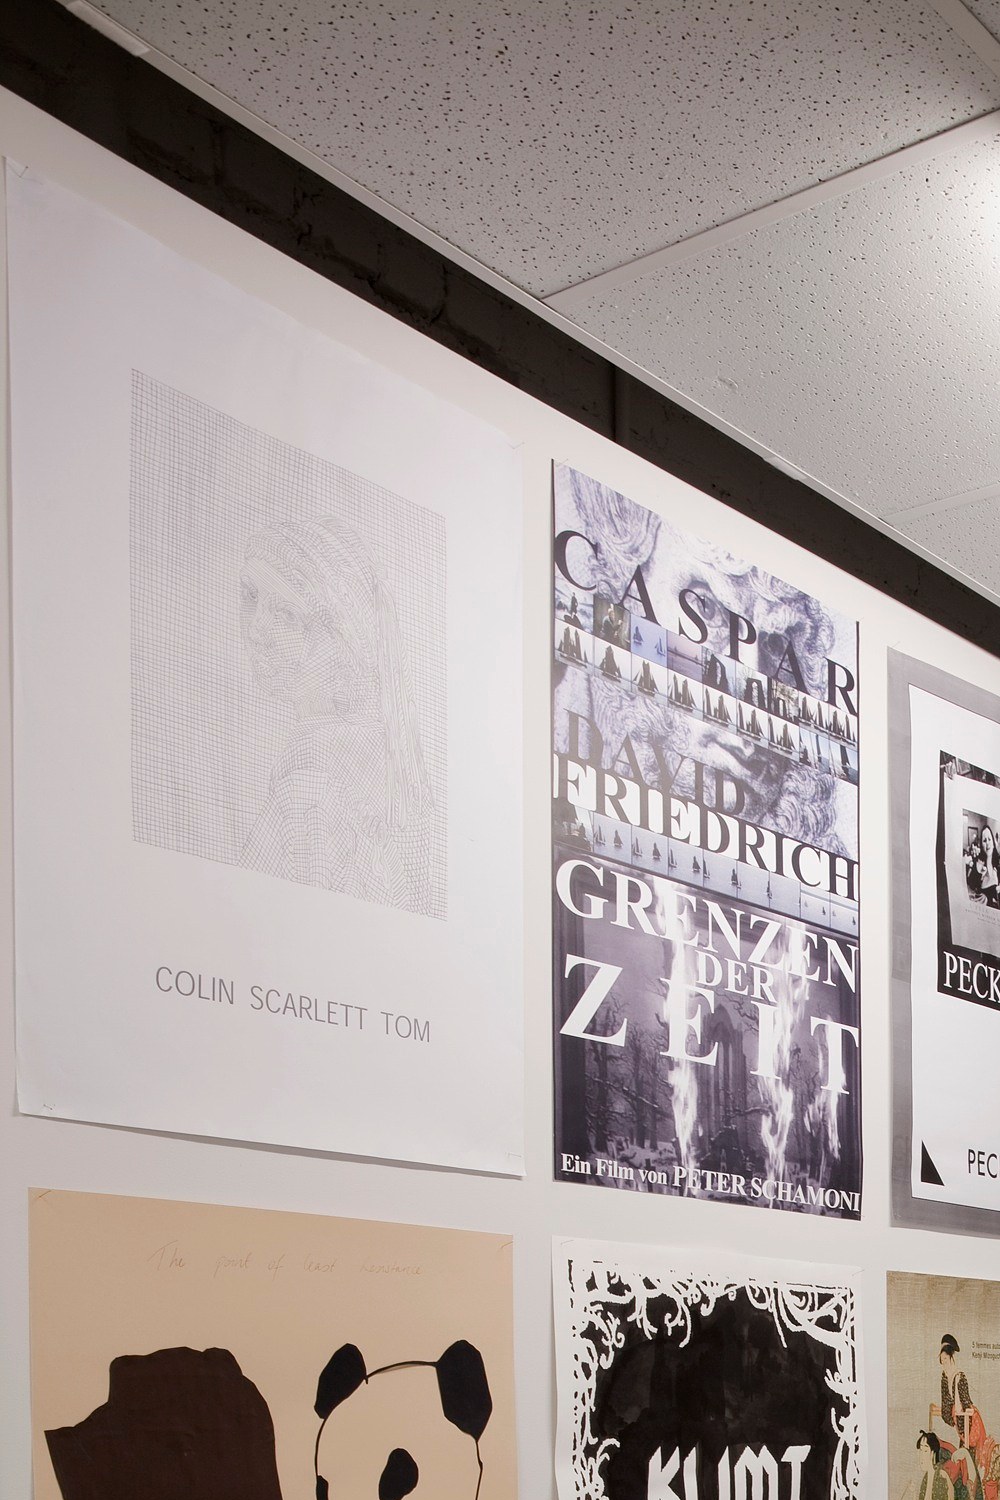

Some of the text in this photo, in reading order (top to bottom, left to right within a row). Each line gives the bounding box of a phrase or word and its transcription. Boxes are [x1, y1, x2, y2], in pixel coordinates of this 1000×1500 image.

[555, 530, 858, 717] CASPAR
[564, 708, 746, 816] DAVID
[556, 756, 859, 902] FRIEDRICH
[555, 858, 859, 994] GRENZEN
[694, 949, 776, 1004] DER
[155, 965, 431, 1044] COLIN SCARLETT TOM
[559, 953, 860, 1095] ZEIT
[560, 1152, 862, 1213] Ein Film von PETER SCHAMONI
[147, 1239, 185, 1270] The
[267, 1253, 286, 1281] of
